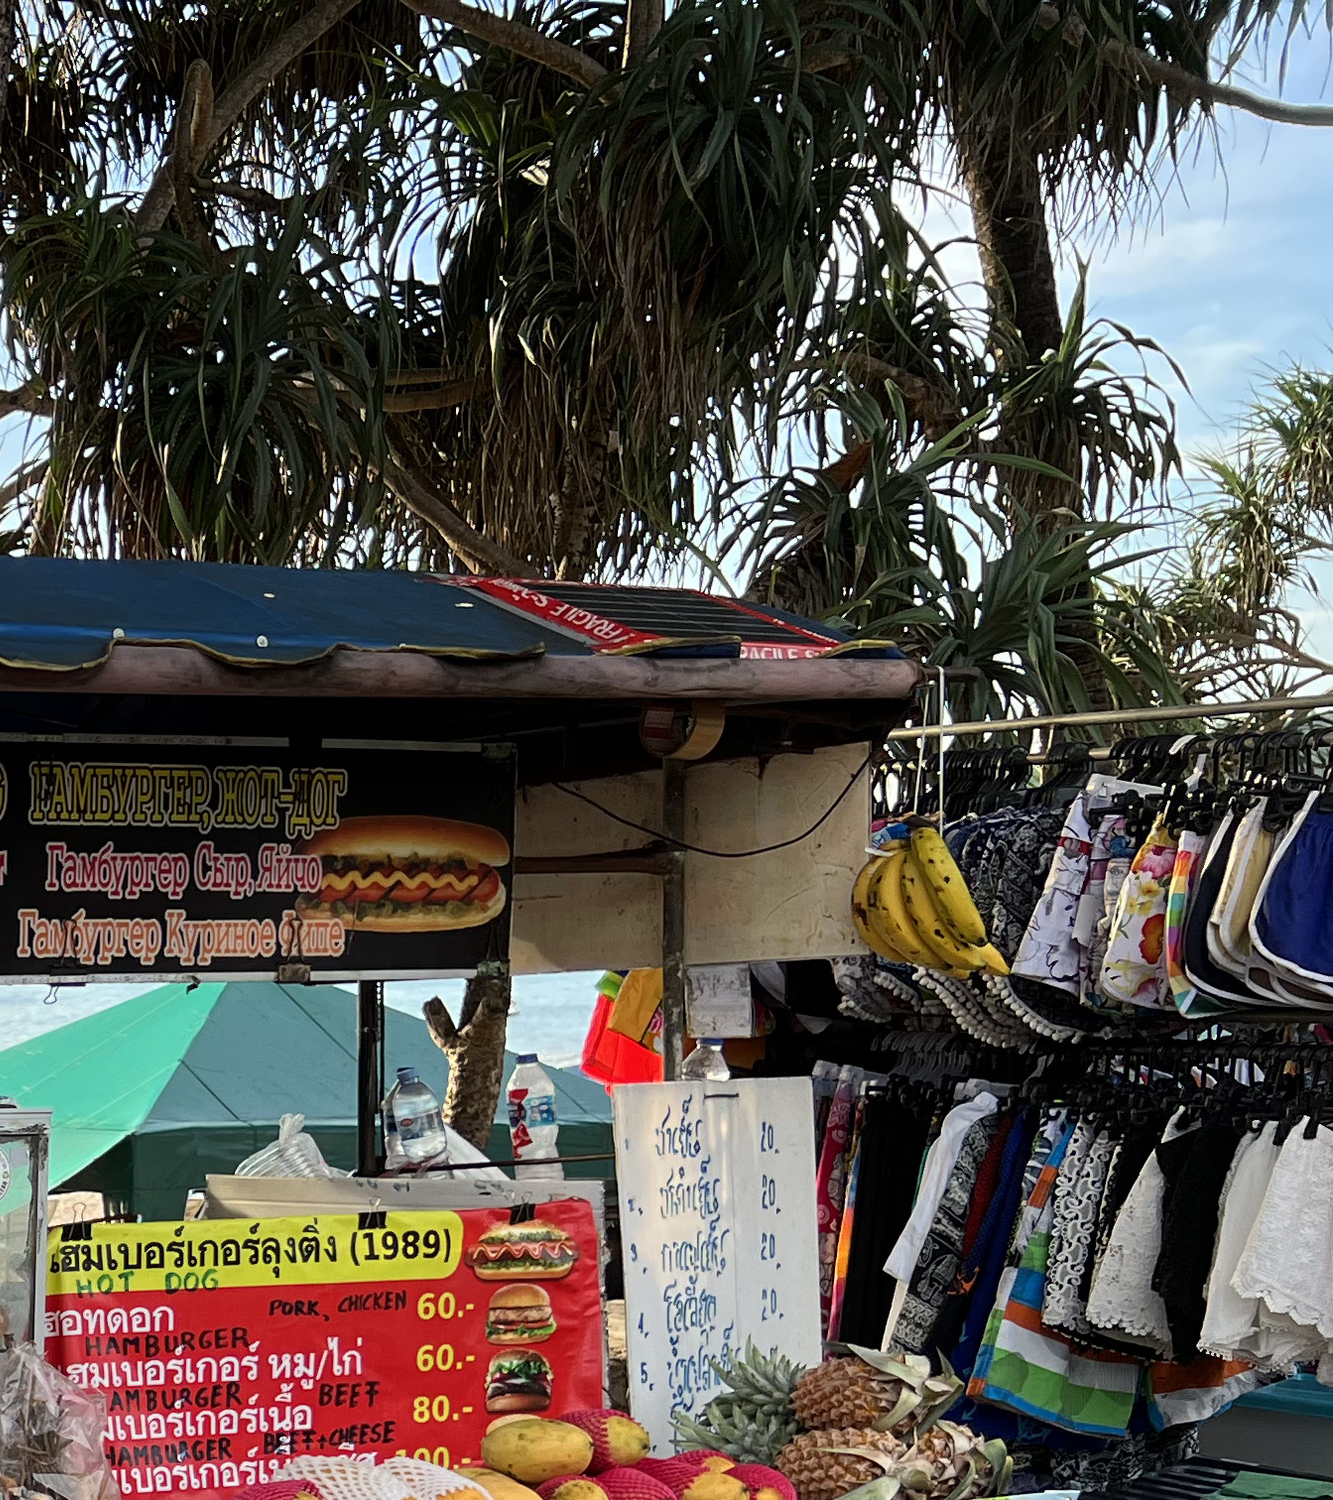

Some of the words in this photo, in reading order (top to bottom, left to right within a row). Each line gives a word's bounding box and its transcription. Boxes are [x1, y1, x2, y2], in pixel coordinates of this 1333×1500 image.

[47, 843, 186, 897] Гамбургер
[165, 911, 275, 964] Куриное
[351, 1229, 452, 1267] (1989)
[76, 1270, 135, 1298] HOT
[164, 1269, 220, 1293] DOG
[337, 1290, 408, 1313] CHICKEN
[417, 1291, 475, 1320] 60.-
[85, 1327, 250, 1357] HAMBURGER
[268, 1336, 363, 1390] หมู/ไก่
[416, 1343, 476, 1371] 60.-
[110, 1383, 243, 1413] AMBURGER
[412, 1395, 474, 1422] 80.-
